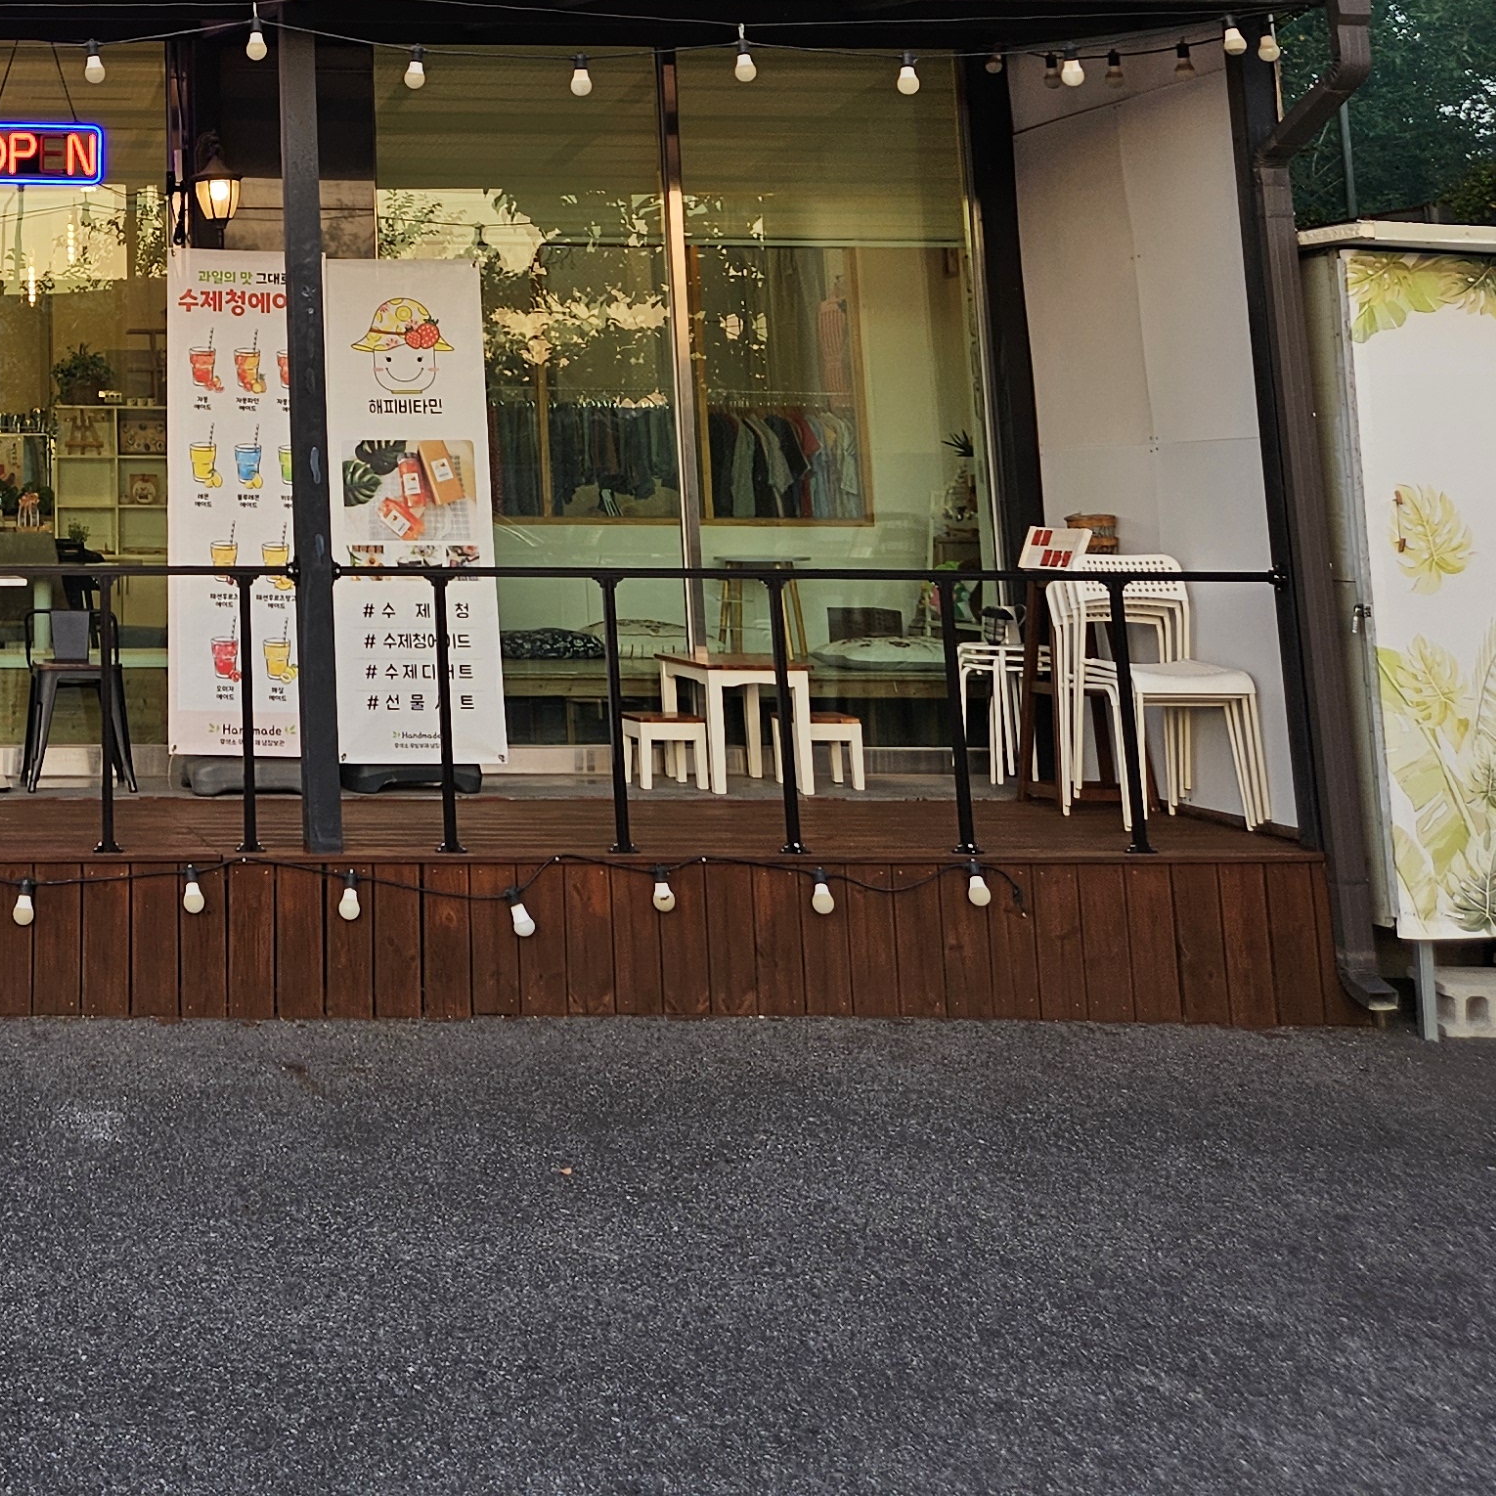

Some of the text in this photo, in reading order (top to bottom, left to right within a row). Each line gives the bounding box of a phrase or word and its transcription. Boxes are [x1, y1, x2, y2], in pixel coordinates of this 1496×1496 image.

[198, 270, 236, 285] 과일의
[240, 271, 252, 285] 맛
[368, 398, 443, 415] 해피비타민
[385, 694, 475, 712] 선물트
[222, 723, 283, 736] Hanmade
